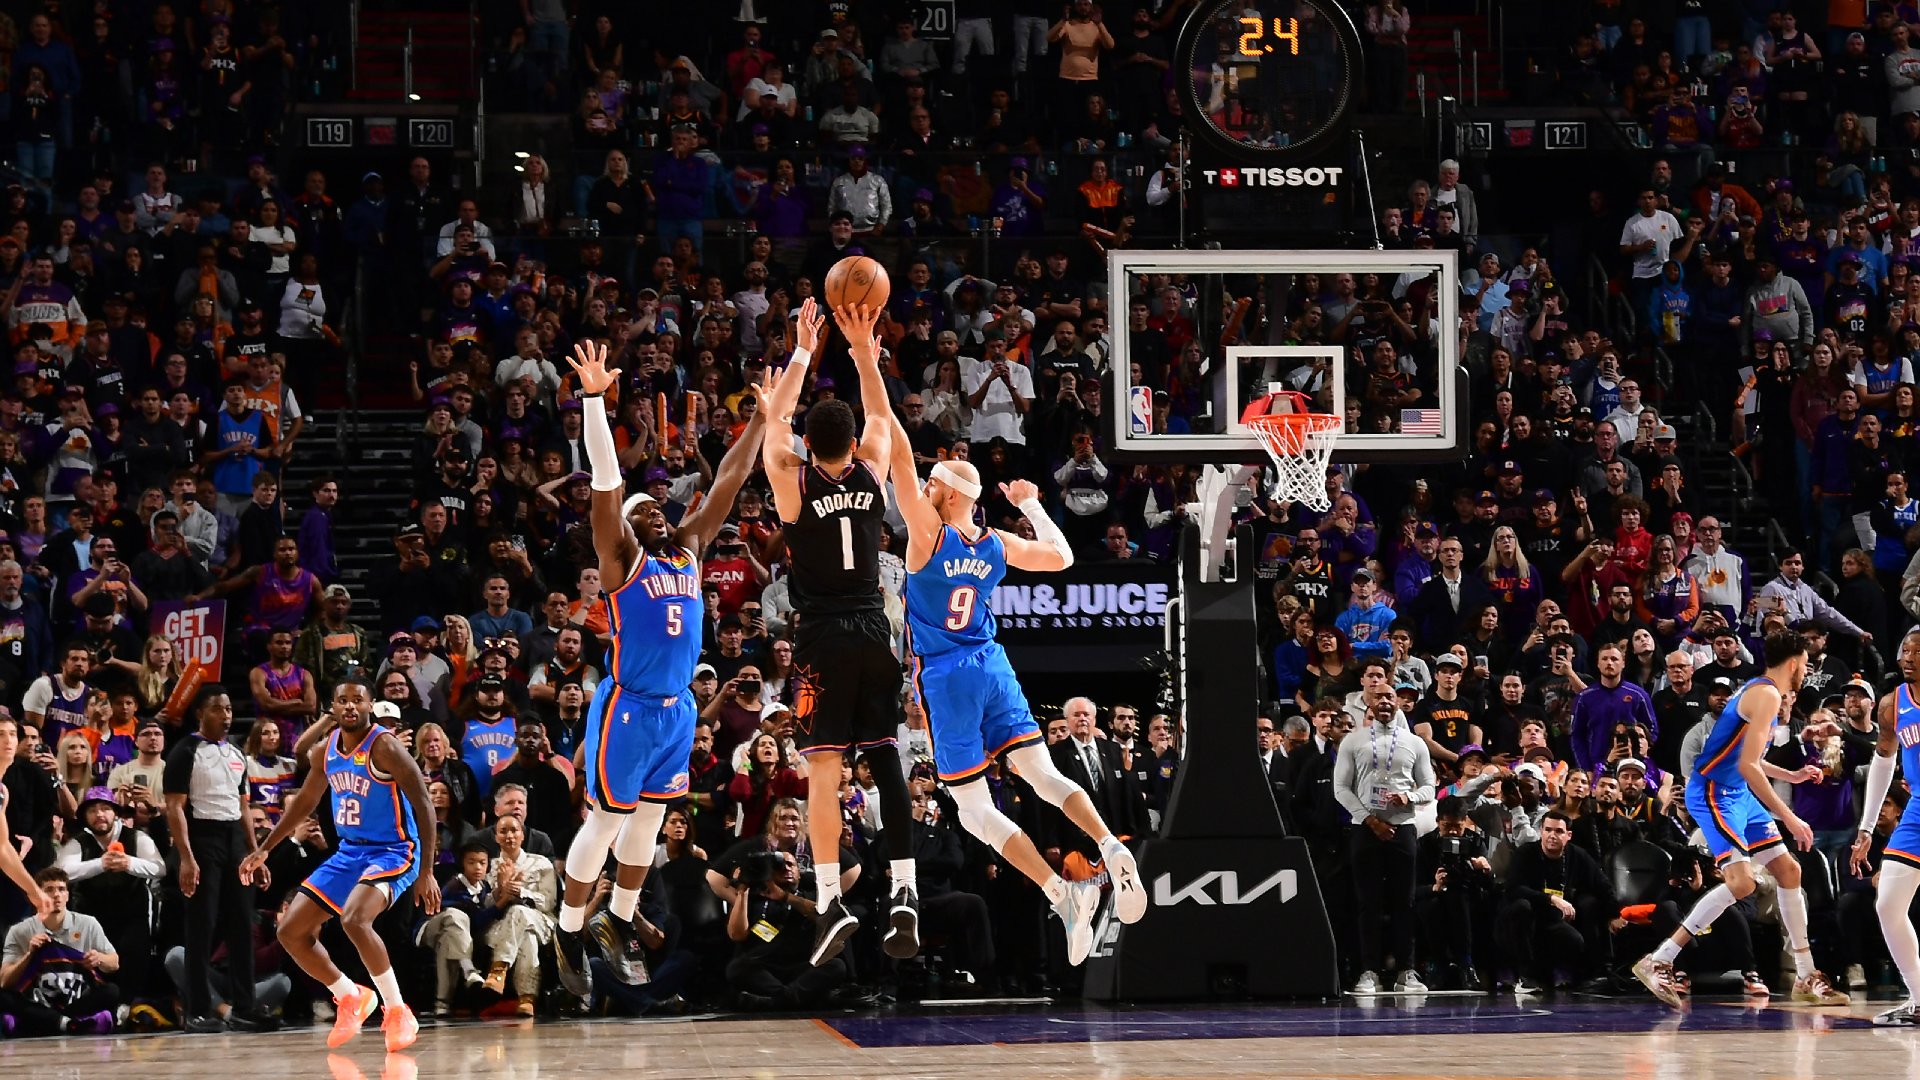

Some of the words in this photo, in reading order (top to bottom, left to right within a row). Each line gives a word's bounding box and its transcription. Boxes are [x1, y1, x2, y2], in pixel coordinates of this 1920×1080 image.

[1239, 17, 1298, 56] 2.4
[210, 58, 236, 71] PHX
[316, 123, 343, 142] 119
[416, 123, 446, 143] 120
[1554, 126, 1578, 145] 121
[1240, 167, 1342, 186] TISSOT
[1850, 319, 1865, 332] 02
[811, 492, 874, 519] BOOKER
[840, 516, 855, 570] 1
[943, 558, 993, 581] CARUSO
[1295, 582, 1329, 598] PHX
[945, 585, 978, 632] 9
[164, 607, 209, 639] GET
[667, 603, 683, 637] 5
[1002, 616, 1042, 629] DRE
[1051, 616, 1092, 628] AND
[12, 640, 22, 656] 8
[1447, 720, 1457, 738] 2
[470, 733, 515, 749] THUNDER
[487, 749, 498, 767] 8
[335, 797, 361, 825] 22
